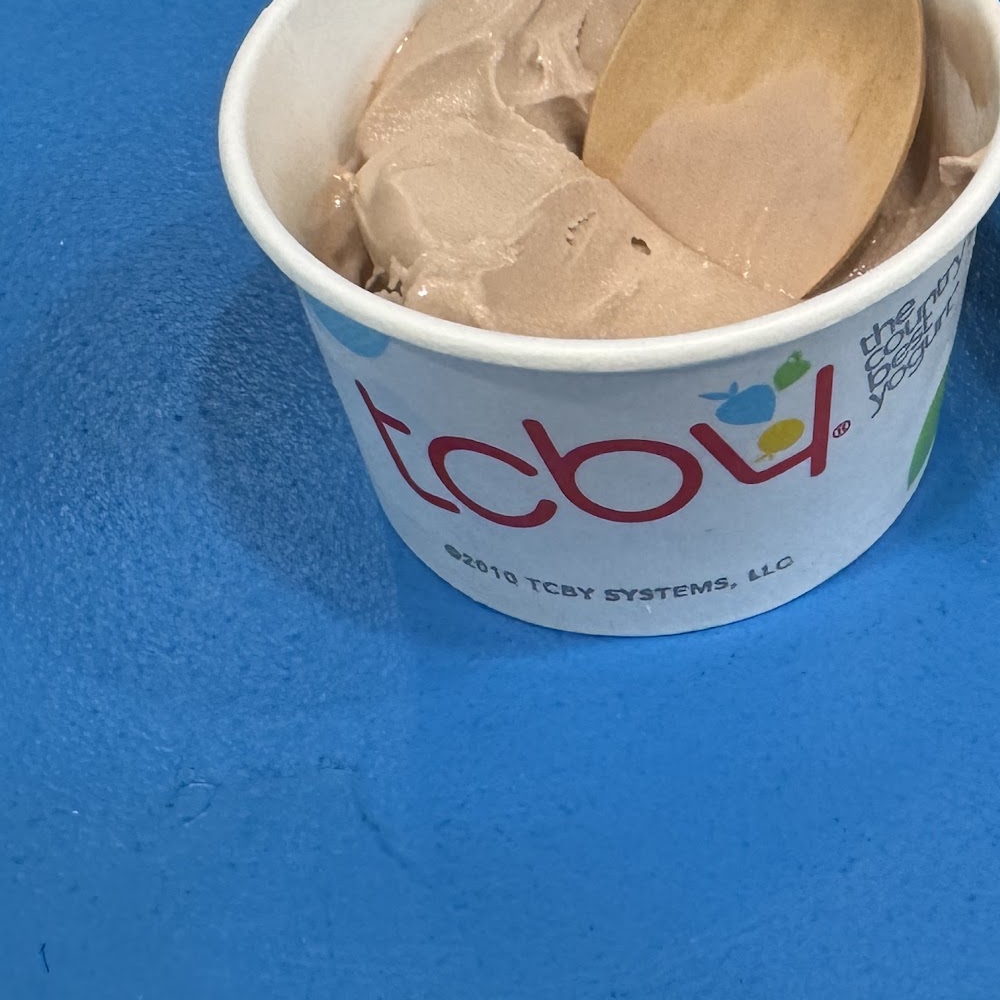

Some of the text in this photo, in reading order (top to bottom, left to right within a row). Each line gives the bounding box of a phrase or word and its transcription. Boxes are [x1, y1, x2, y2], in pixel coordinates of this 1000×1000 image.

[860, 298, 916, 356] the
[867, 308, 933, 393] best
[869, 281, 959, 418] yogurt
[355, 364, 835, 528] tcby
[524, 576, 595, 600] TCBY
[604, 567, 737, 601] SYSTEMS,
[748, 556, 794, 582] LLC
